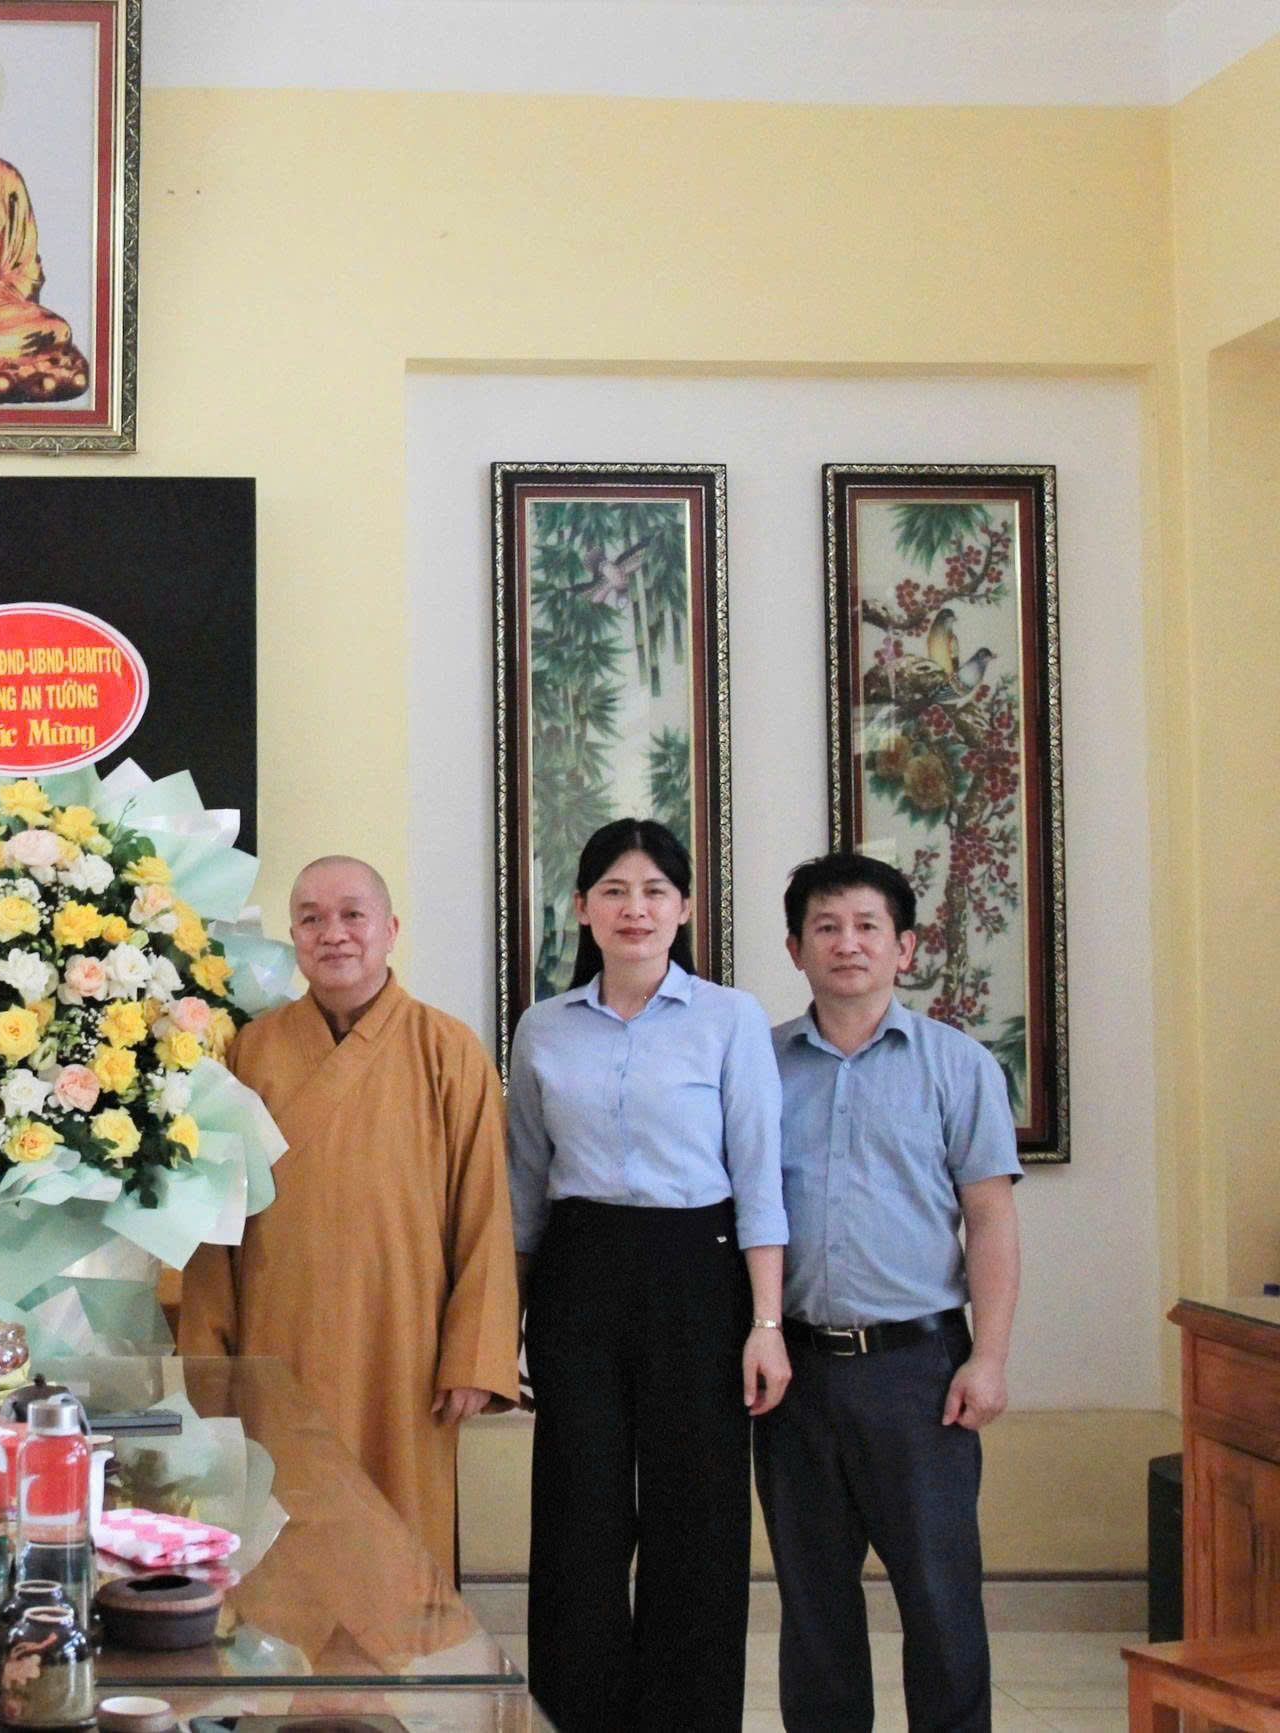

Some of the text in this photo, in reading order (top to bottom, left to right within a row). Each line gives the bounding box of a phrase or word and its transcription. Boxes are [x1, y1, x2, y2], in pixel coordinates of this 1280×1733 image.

[21, 685, 42, 710] AN
[46, 678, 98, 709] TƯỜNG
[27, 719, 96, 751] Mừng
